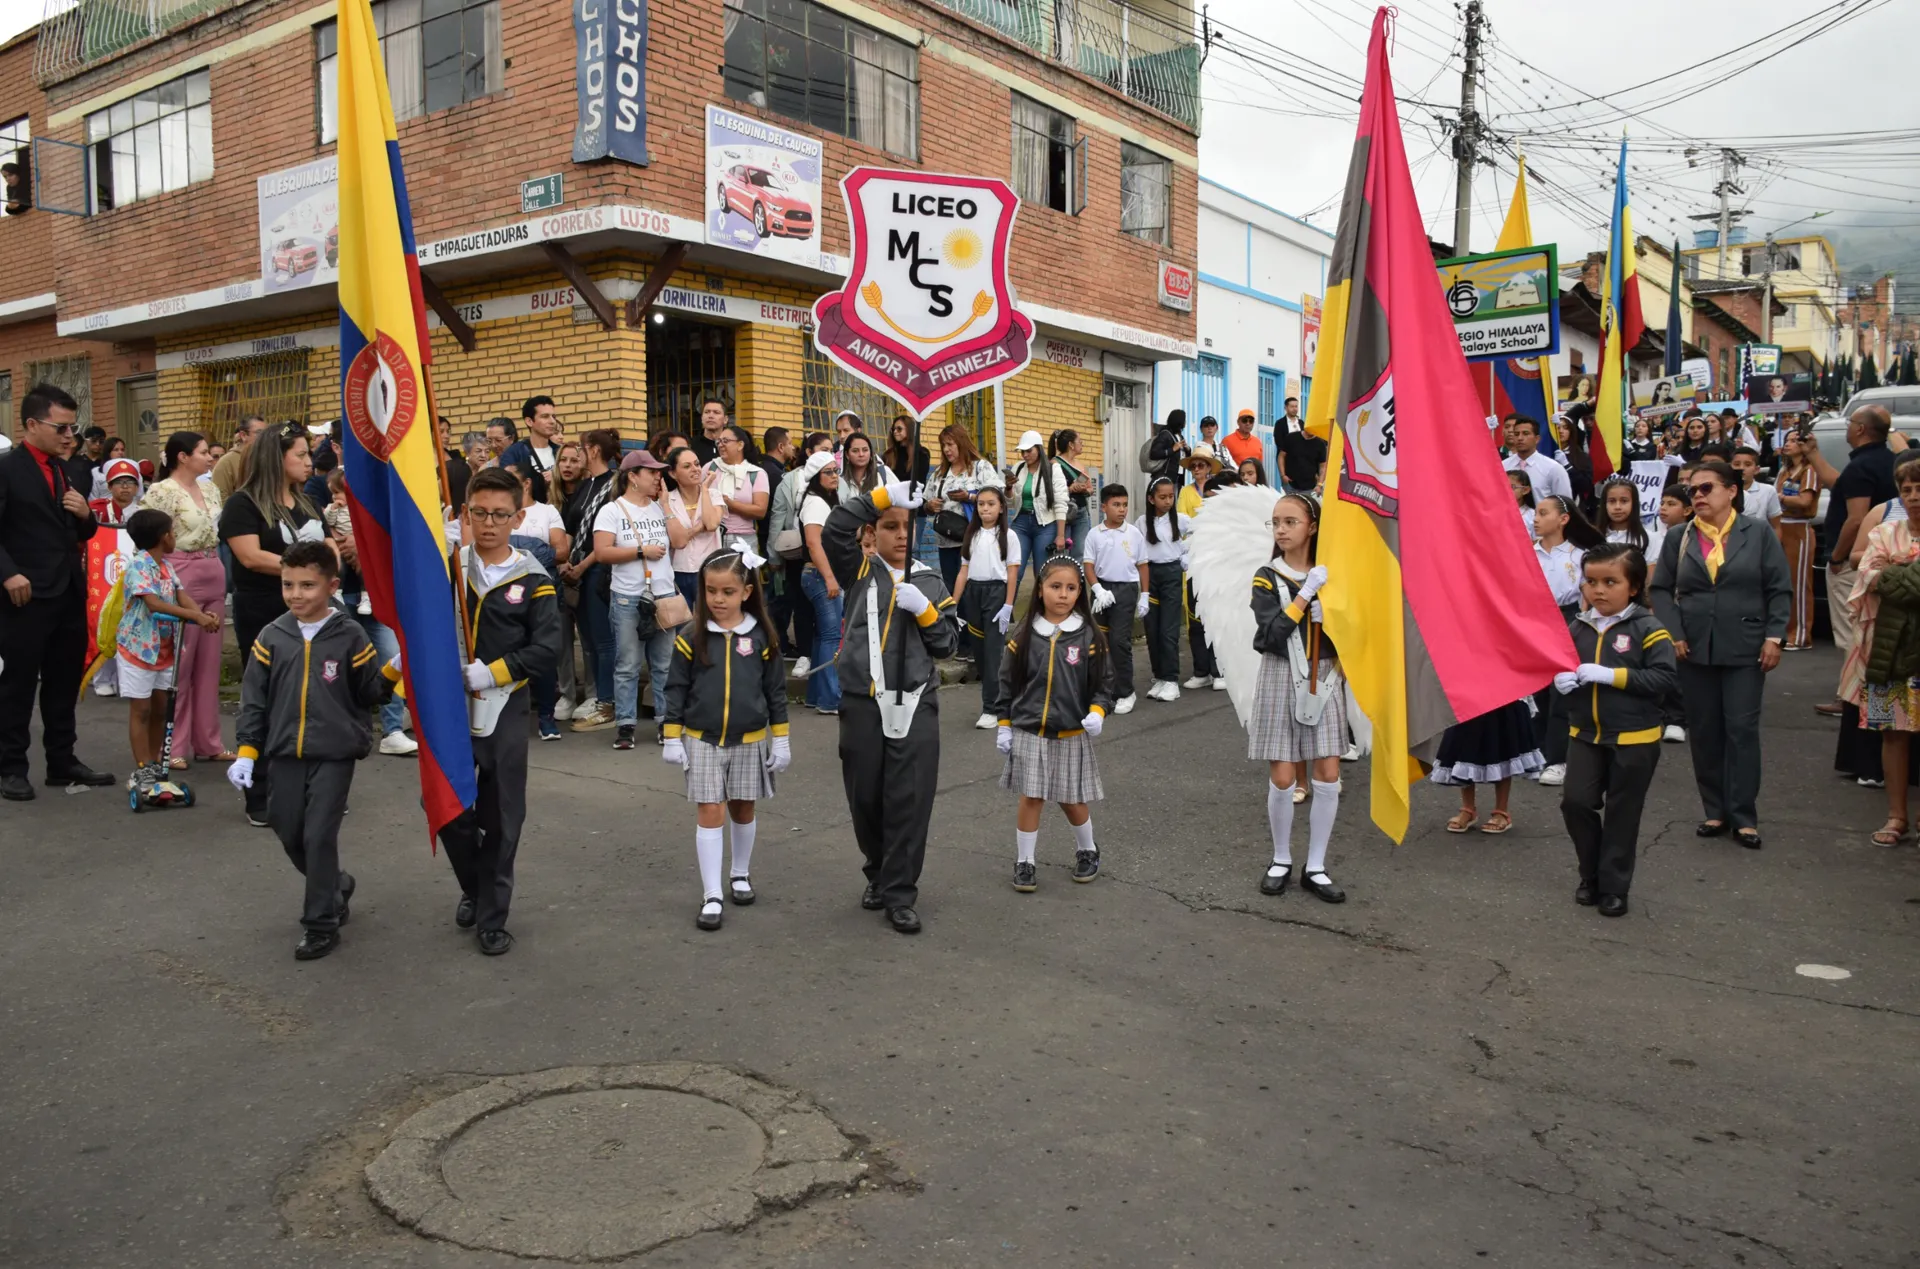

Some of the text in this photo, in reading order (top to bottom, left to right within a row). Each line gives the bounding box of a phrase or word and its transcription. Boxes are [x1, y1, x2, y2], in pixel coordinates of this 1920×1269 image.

[714, 113, 818, 157] LA ESQUINA DEL CAUCHO
[264, 164, 338, 198] LA ESQUINA DE
[550, 178, 555, 191] 6
[783, 173, 797, 183] KIA
[551, 193, 555, 204] 3
[892, 192, 977, 220] LICEO
[542, 209, 603, 237] CORREAS
[620, 208, 670, 234] LUJOS
[819, 254, 837, 272] ES
[148, 297, 187, 317] SOPORTES
[531, 287, 575, 310] BUJES
[84, 314, 109, 330] LUJOS
[1458, 323, 1546, 342] EGIO HIMALAYA
[251, 335, 296, 354] TORNILLERIA
[1046, 340, 1080, 356] PUERTAS
[1461, 335, 1538, 352] malaya School
[184, 348, 214, 361] LUJOS
[847, 338, 1009, 386] AMOR Y FIRMEZA
[1045, 349, 1083, 368] VIDRIOS
[621, 518, 666, 532] Bonjou
[648, 530, 666, 539] amo
[162, 722, 175, 774] SCOOTER
